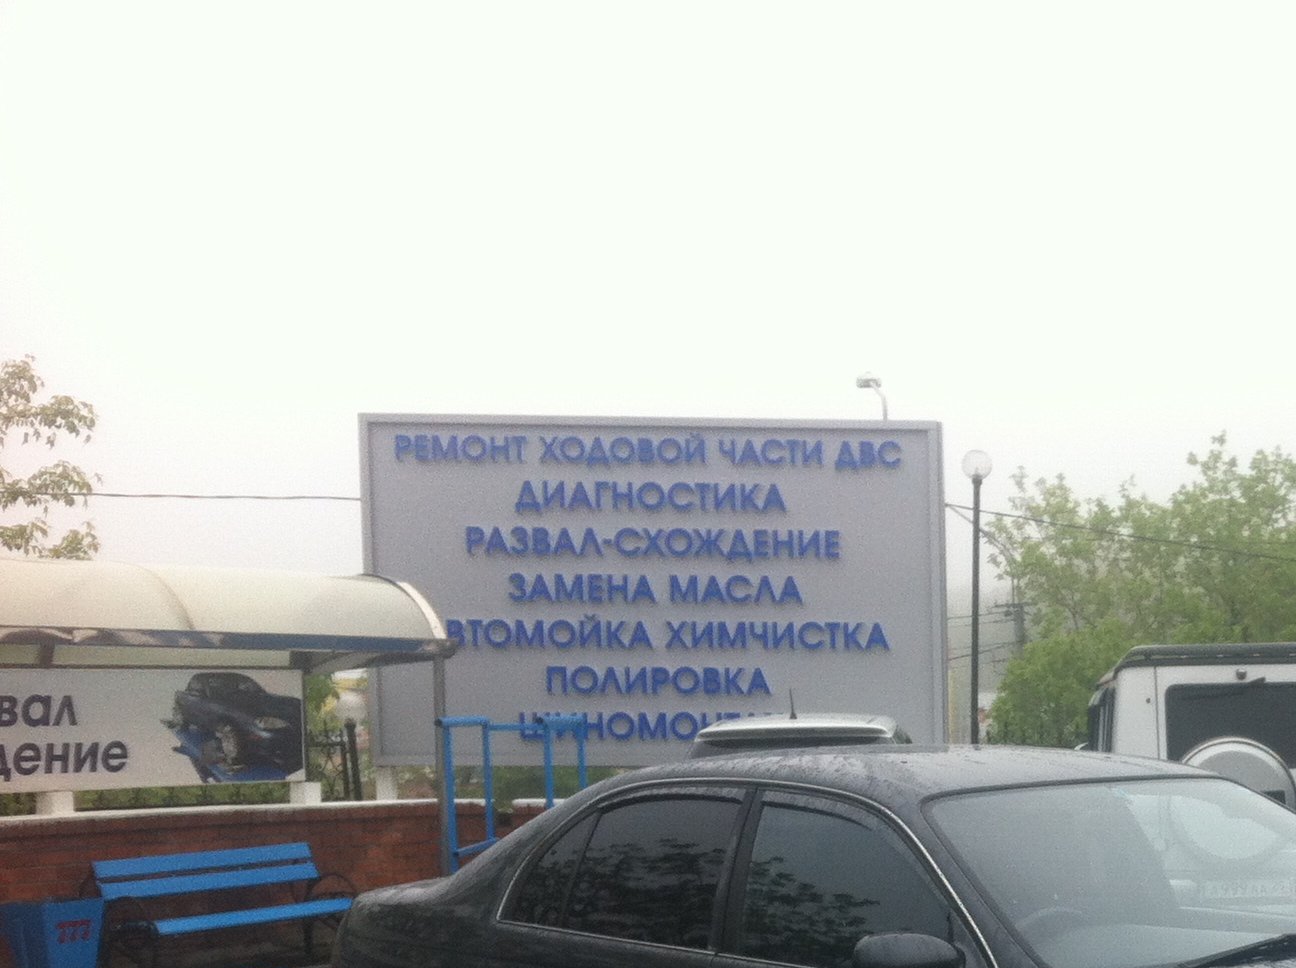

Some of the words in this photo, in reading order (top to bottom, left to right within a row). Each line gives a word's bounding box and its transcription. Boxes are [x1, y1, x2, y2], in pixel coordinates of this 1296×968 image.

[395, 434, 527, 464] РЕМОНТ
[539, 432, 706, 467] ХОДОВОЙ
[718, 438, 823, 466] ЧАСТИ
[834, 440, 902, 472] ДВС
[515, 480, 787, 512] ДИАГНОСТИКА
[465, 526, 841, 563] РАЗВАЛ-СХОЖДЕНИЕ
[509, 573, 656, 604] ЗАМЕНА
[669, 575, 803, 604] МАСЛА
[446, 613, 655, 648] ВТОМОЙКА
[665, 620, 890, 650] ХИМЧИСТКА
[546, 666, 771, 695] ПОЛИРОВКА
